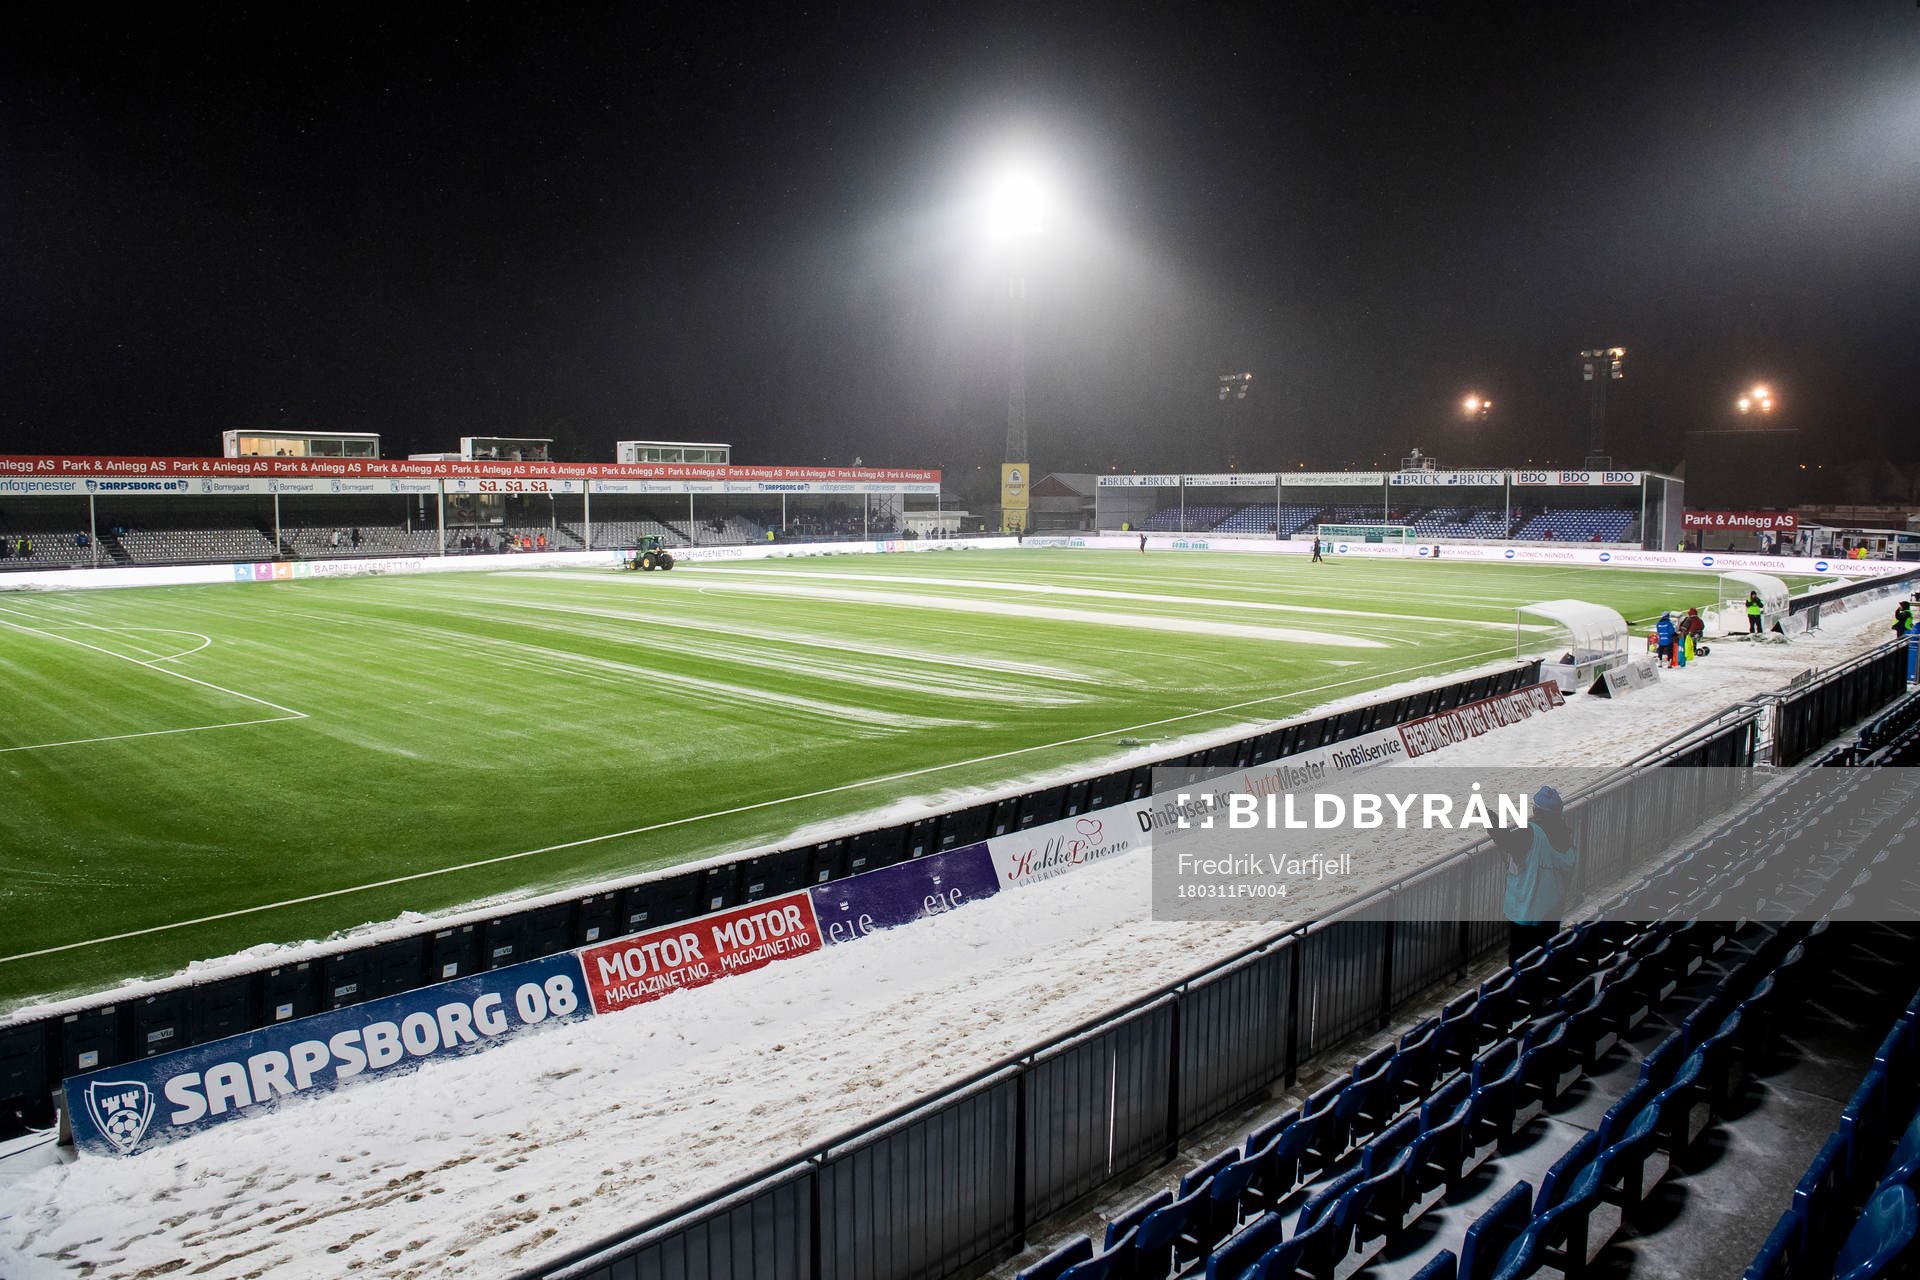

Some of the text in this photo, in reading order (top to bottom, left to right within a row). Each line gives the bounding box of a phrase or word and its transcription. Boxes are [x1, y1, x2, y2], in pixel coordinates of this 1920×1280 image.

[0, 460, 55, 472] nlegg AS
[62, 461, 166, 472] Park & Anlegg AS
[174, 462, 268, 472] Park & Anlegg AS
[275, 462, 361, 473] Park & Anlegg AS
[367, 464, 446, 474] Park & Anlegg AS
[452, 464, 472, 473] Park
[474, 465, 480, 474] &
[482, 466, 512, 475] Anlegg
[530, 466, 548, 474] Park
[550, 466, 556, 474] &
[558, 466, 586, 476] Anlegg
[621, 467, 626, 475] &
[628, 468, 652, 476] Anlegg
[692, 468, 714, 477] Anlegg
[751, 469, 772, 477] Anlegg
[786, 469, 799, 477] Park
[806, 470, 826, 478] Anlegg
[858, 470, 876, 479] Anlegg
[905, 472, 922, 480] Anlegg
[1107, 477, 1134, 486] BRICK
[1148, 476, 1176, 486] BRICK
[1403, 474, 1440, 484] BRICK
[1459, 474, 1498, 484] BRICK
[1520, 472, 1547, 482] BDO
[1563, 472, 1590, 482] BDO
[1607, 472, 1634, 482] BDO
[0, 479, 76, 493] nfotjenester
[100, 482, 177, 490] SARPSBORG 08
[214, 483, 250, 491] Borregaard
[1685, 514, 1794, 528] Park & Anlegg AS
[1402, 714, 1464, 756] FREDRIKSTAD
[1332, 738, 1401, 771] DinBilservice
[1243, 760, 1326, 800] AutoMester
[1008, 834, 1128, 881] KokkeLine.no
[1018, 867, 1067, 887] CATERING
[924, 887, 962, 916] eie
[711, 904, 805, 954] MOTOR
[829, 914, 873, 943] eie
[720, 932, 810, 970] MAGAZINET.NO
[597, 932, 704, 986] MOTOR
[604, 962, 710, 1005] MAGAZINET.NO
[164, 974, 578, 1126] SARPSBORG 08
